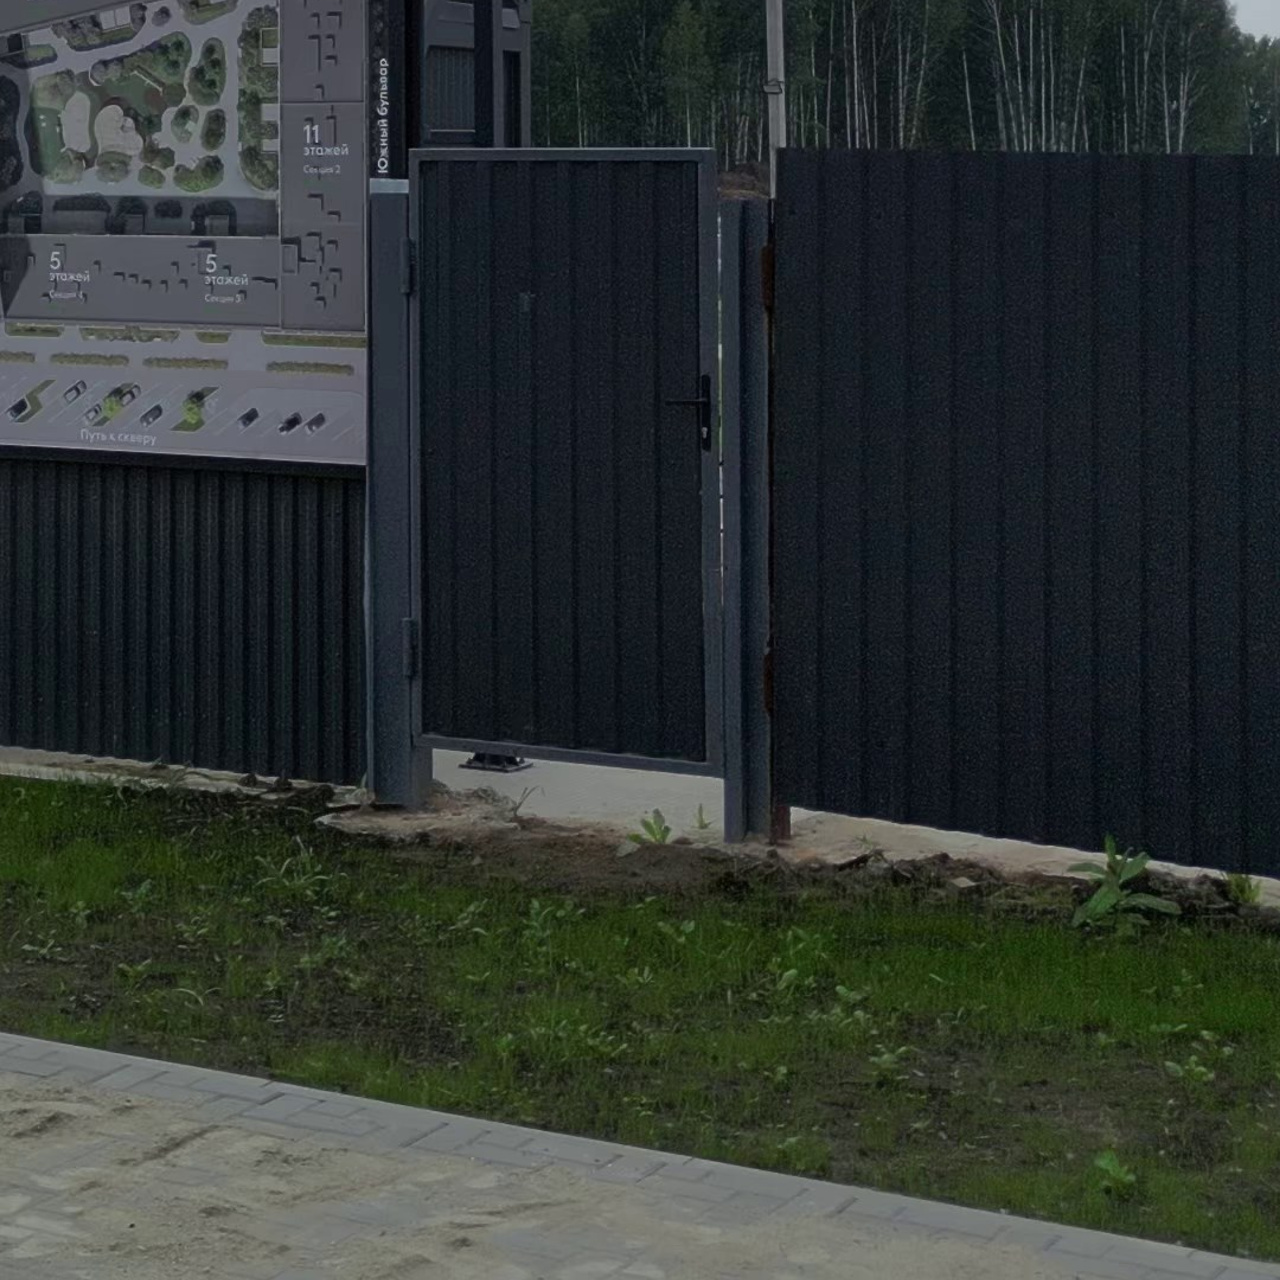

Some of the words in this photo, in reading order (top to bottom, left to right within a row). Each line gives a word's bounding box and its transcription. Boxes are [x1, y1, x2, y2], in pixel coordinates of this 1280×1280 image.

[376, 58, 390, 117] бульвар
[303, 124, 319, 144] 11
[303, 143, 349, 156] этажей
[377, 119, 389, 174] Южный
[49, 251, 61, 270] 5
[205, 253, 217, 273] 5
[49, 270, 90, 282] этажей
[204, 273, 249, 286] этажей
[80, 428, 108, 444] Путь
[109, 432, 117, 442] к
